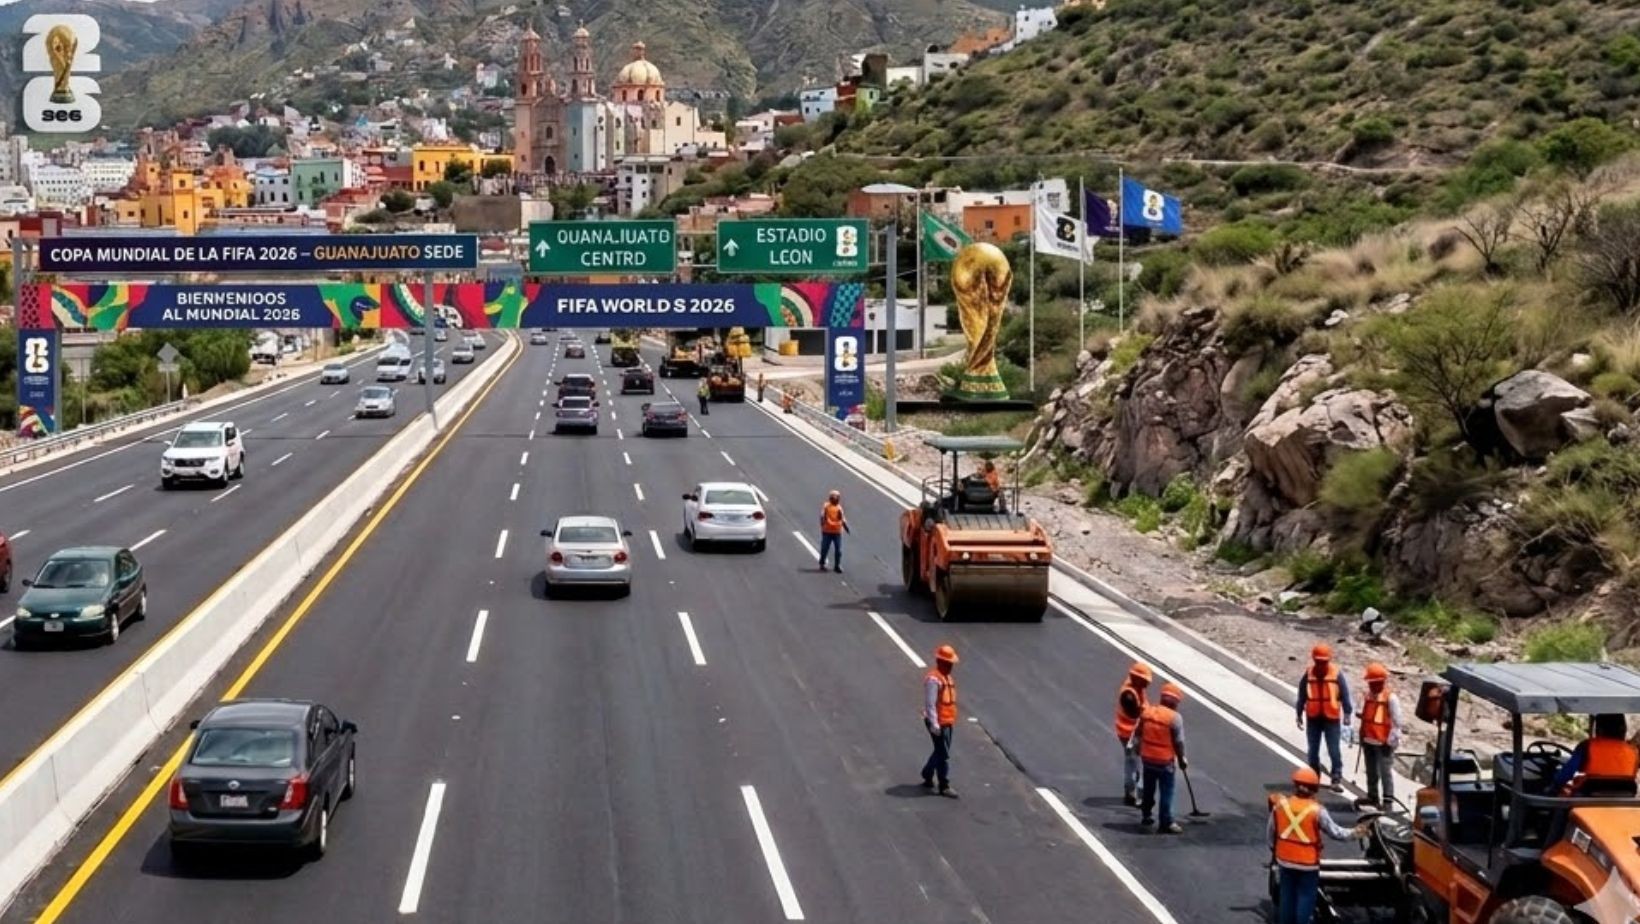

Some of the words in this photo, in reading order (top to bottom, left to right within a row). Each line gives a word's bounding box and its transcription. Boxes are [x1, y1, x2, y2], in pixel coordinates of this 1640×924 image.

[756, 228, 826, 243] ESTADIO
[51, 249, 93, 262] COPA
[97, 248, 170, 261] MUNDIAL
[174, 247, 195, 260] DE
[199, 247, 219, 260] LA
[223, 247, 256, 260] FIFA
[259, 247, 298, 260] 2026
[314, 245, 420, 260] GUANAJUATO
[424, 245, 464, 259] SEDE
[557, 298, 598, 313] FIFA
[601, 298, 670, 313] WORLD
[690, 298, 735, 313] 2026
[162, 308, 183, 321] AL
[186, 308, 260, 321] MUNDIAL
[263, 308, 301, 321] 2026
